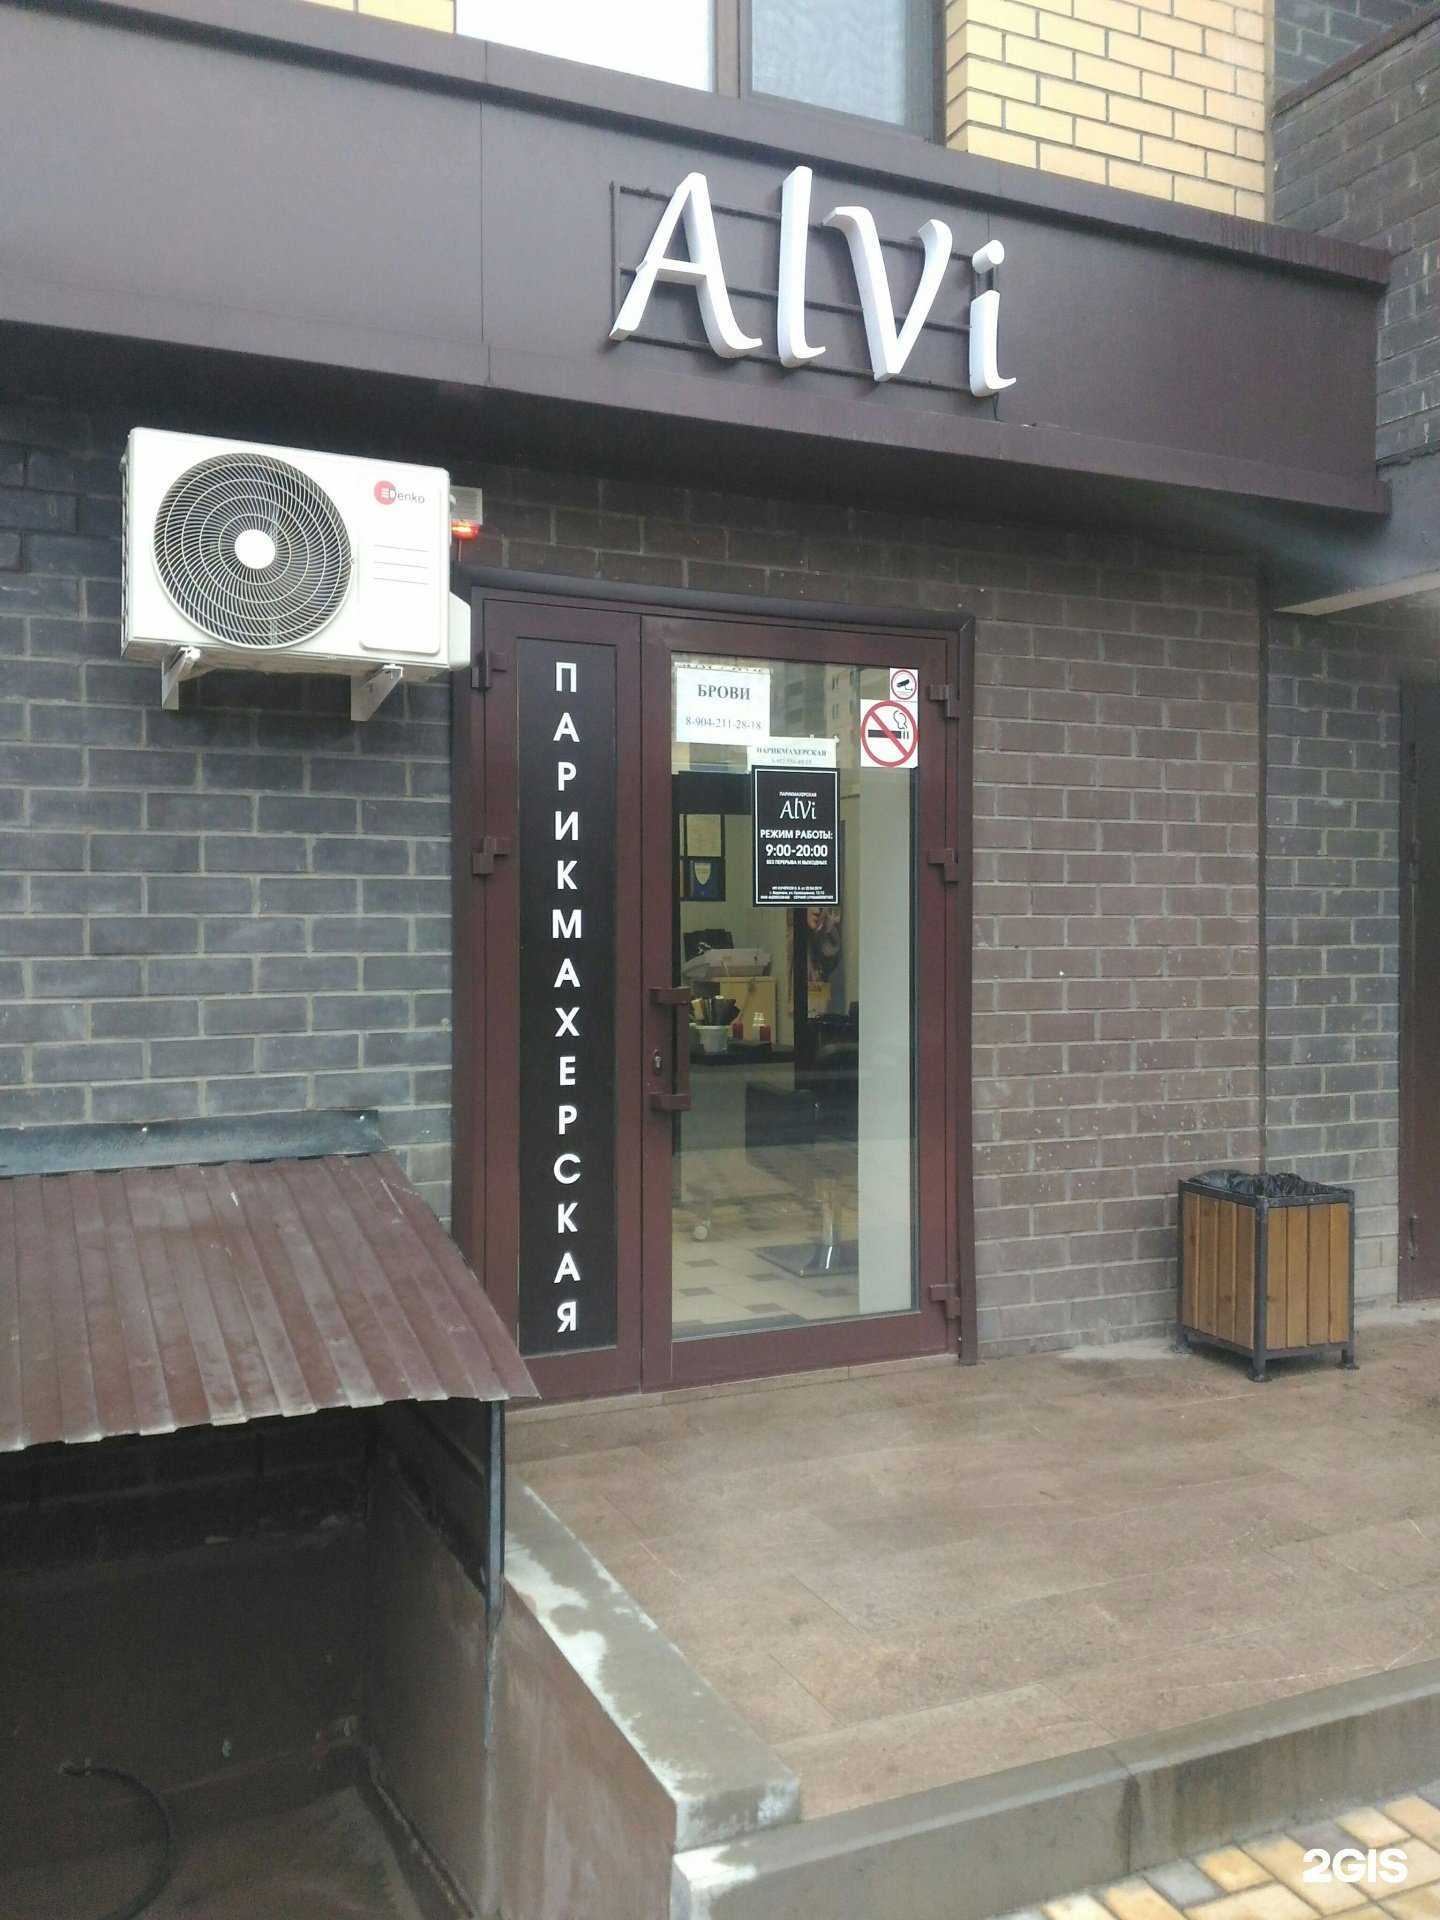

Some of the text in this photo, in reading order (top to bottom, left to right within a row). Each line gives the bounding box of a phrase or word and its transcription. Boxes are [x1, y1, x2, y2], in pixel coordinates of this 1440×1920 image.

[697, 684, 751, 700] БРОВИ
[760, 829, 833, 840] РЕЖИМ РАБОТЫ:
[765, 843, 828, 857] 9:00-20:00
[552, 661, 582, 1333] ПАРИКМАХЕРСКАЯ
